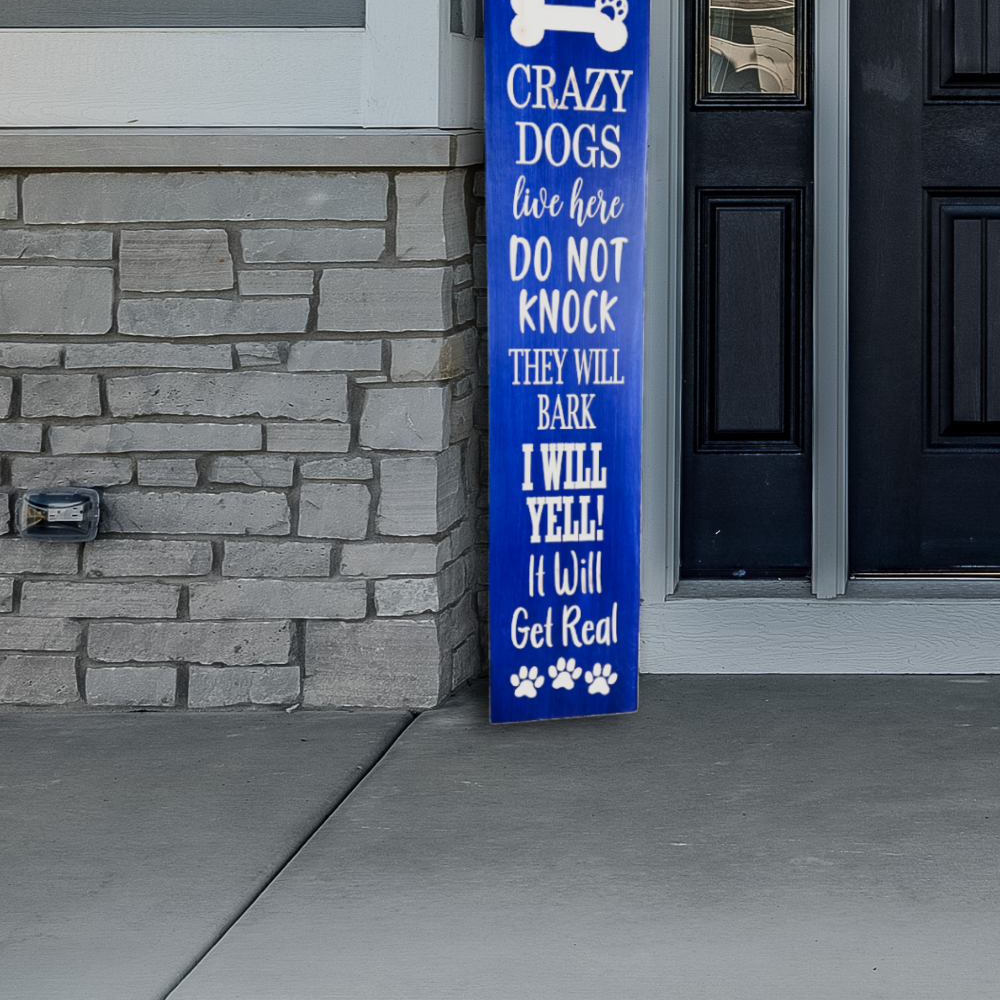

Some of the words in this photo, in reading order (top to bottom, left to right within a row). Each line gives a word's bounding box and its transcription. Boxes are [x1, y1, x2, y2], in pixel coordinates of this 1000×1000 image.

[507, 64, 633, 112] CRAZY
[515, 122, 621, 168] DOGS
[513, 175, 563, 219] live
[570, 177, 624, 227] here
[510, 235, 552, 281] DO
[568, 236, 629, 283] NOT
[519, 288, 618, 334] KNOCK
[509, 349, 568, 385] THEY
[573, 349, 624, 384] WILL
[538, 394, 596, 430] BARK
[522, 444, 533, 491] I
[540, 443, 606, 491] WILL
[527, 495, 603, 543] YELL!
[529, 555, 544, 596] It
[555, 550, 601, 595] Will
[511, 607, 553, 649] Get
[563, 602, 617, 647] Real
